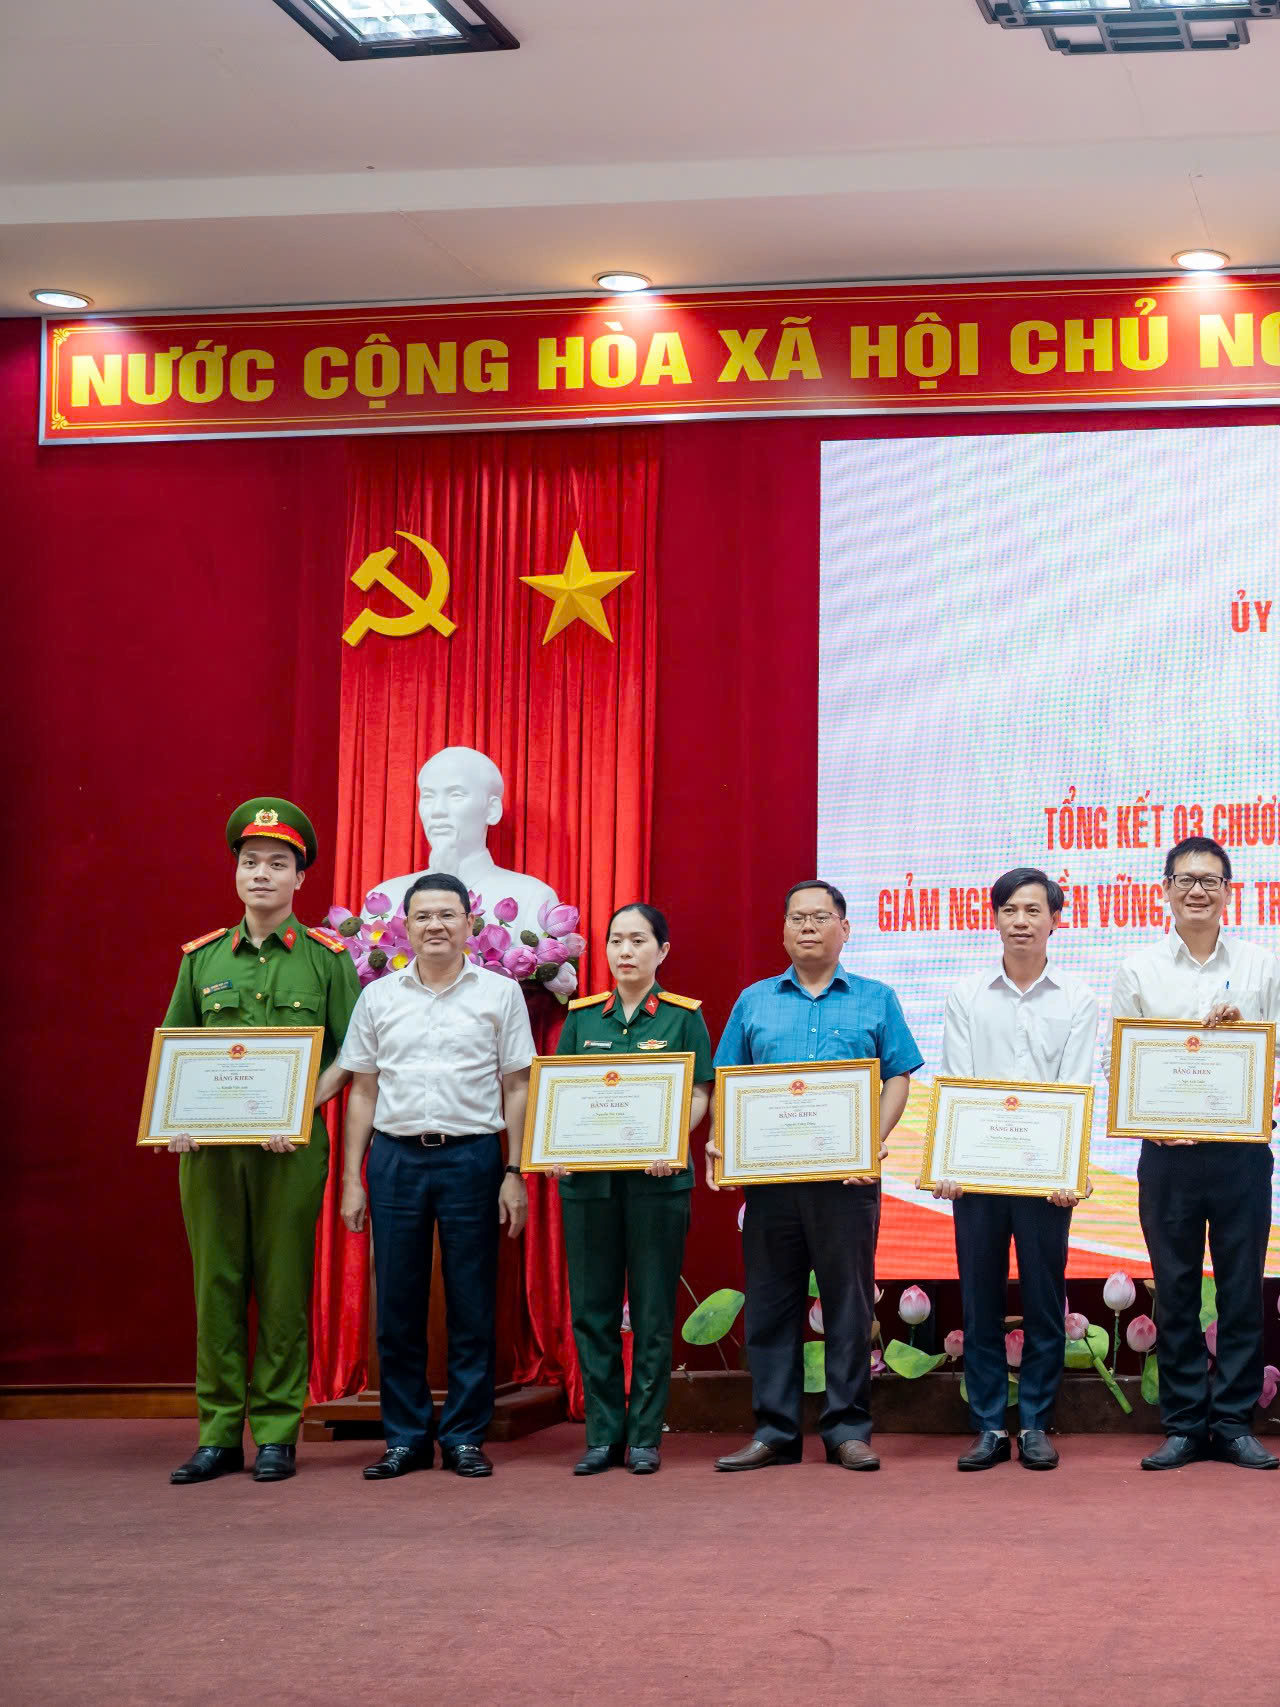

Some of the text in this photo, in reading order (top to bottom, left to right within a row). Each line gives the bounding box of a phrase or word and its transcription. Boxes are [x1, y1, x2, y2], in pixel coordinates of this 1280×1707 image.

[69, 340, 273, 407] NƯỚC
[304, 334, 508, 410] CỘNG
[538, 321, 693, 391] HÒA
[717, 317, 822, 382] XÃ
[851, 313, 978, 389] HỘI
[1009, 297, 1169, 373] CHỦ
[1232, 590, 1272, 632] ỦY
[1045, 786, 1107, 849] TỔNG
[1118, 791, 1164, 848] KẾT
[1174, 805, 1203, 845] 03
[879, 873, 939, 931] GIẢM
[950, 888, 994, 930] NGH
[1059, 870, 1088, 928] ỀN
[1098, 874, 1170, 934] VỮNG,
